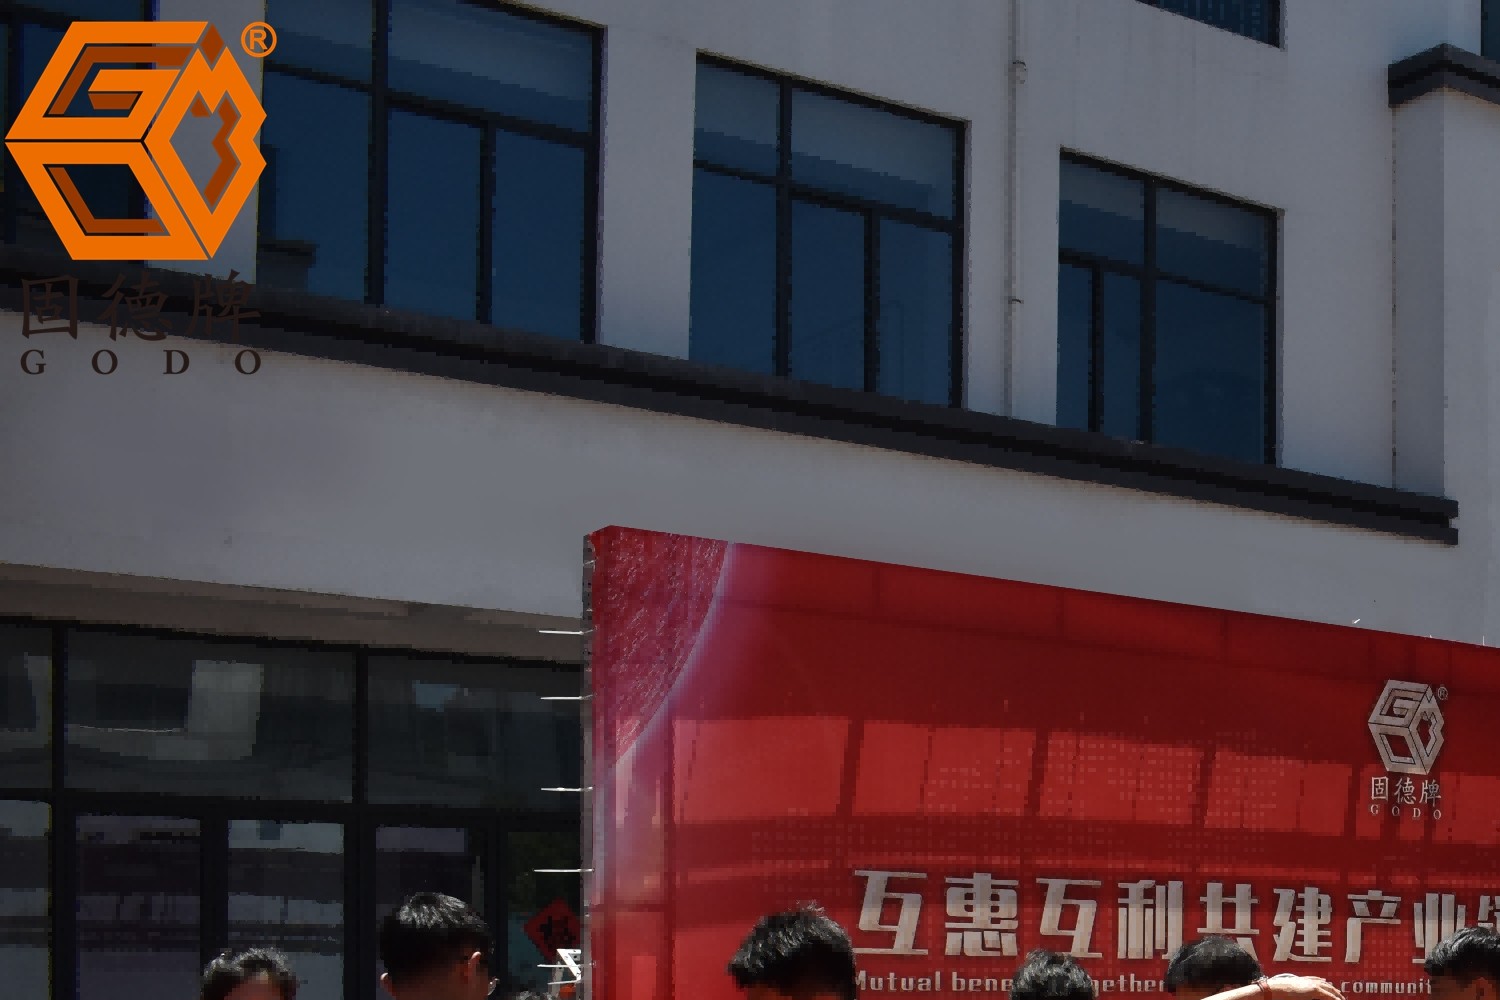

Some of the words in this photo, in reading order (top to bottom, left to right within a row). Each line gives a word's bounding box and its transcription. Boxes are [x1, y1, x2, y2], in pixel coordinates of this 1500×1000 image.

[1370, 776, 1442, 807] 固德牌
[1370, 804, 1442, 820] GODO
[854, 970, 941, 992] Mutual
